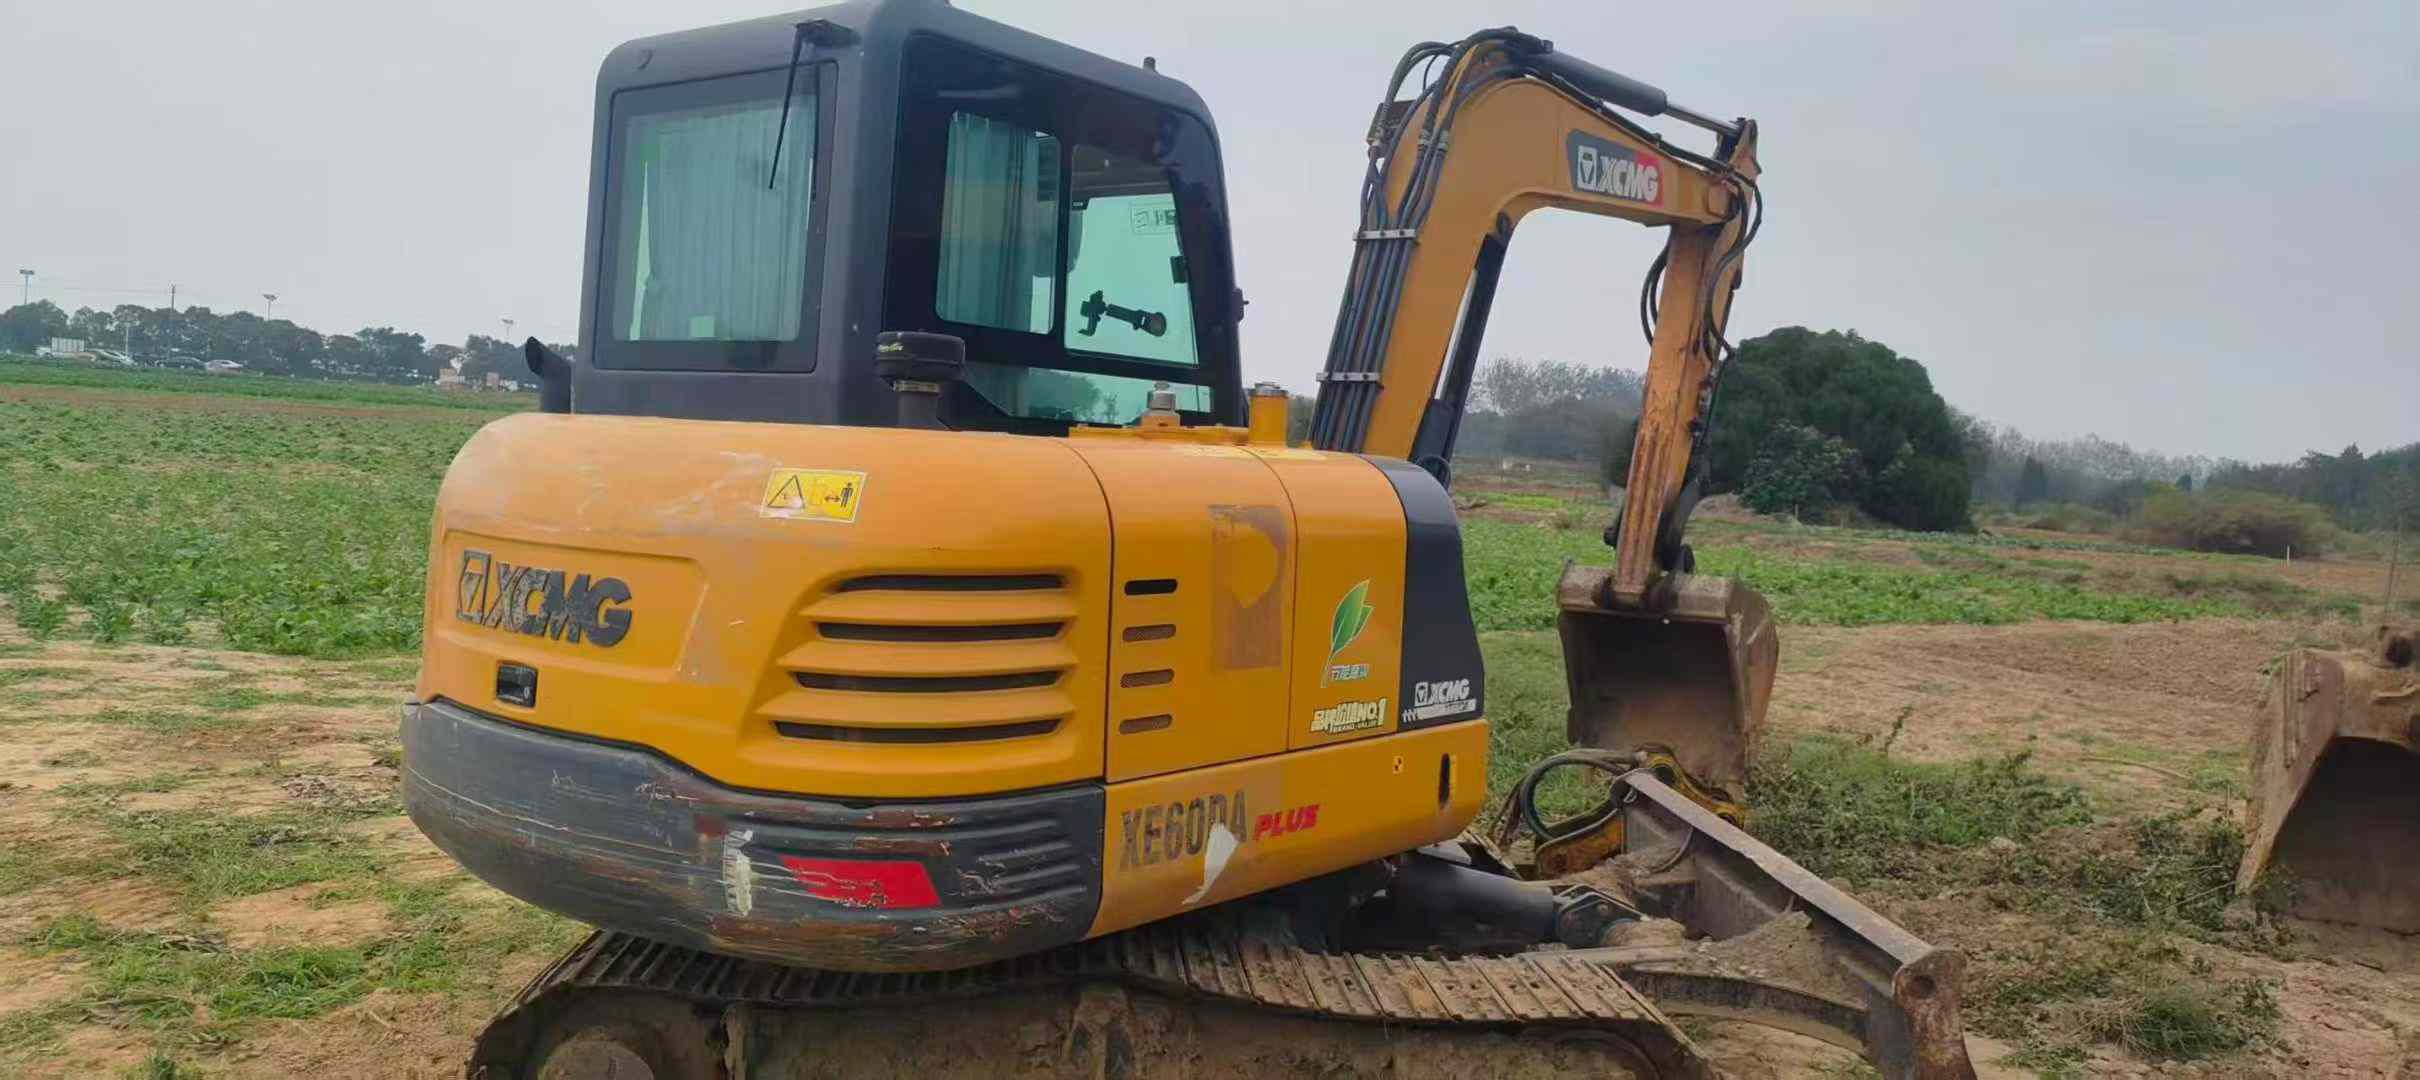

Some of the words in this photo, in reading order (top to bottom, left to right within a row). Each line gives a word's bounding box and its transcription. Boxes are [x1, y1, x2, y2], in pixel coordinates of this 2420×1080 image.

[1598, 156, 1659, 202] XCMG
[484, 561, 633, 648] XCMG
[1427, 678, 1470, 705] XCMG
[1252, 804, 1321, 841] PLUS
